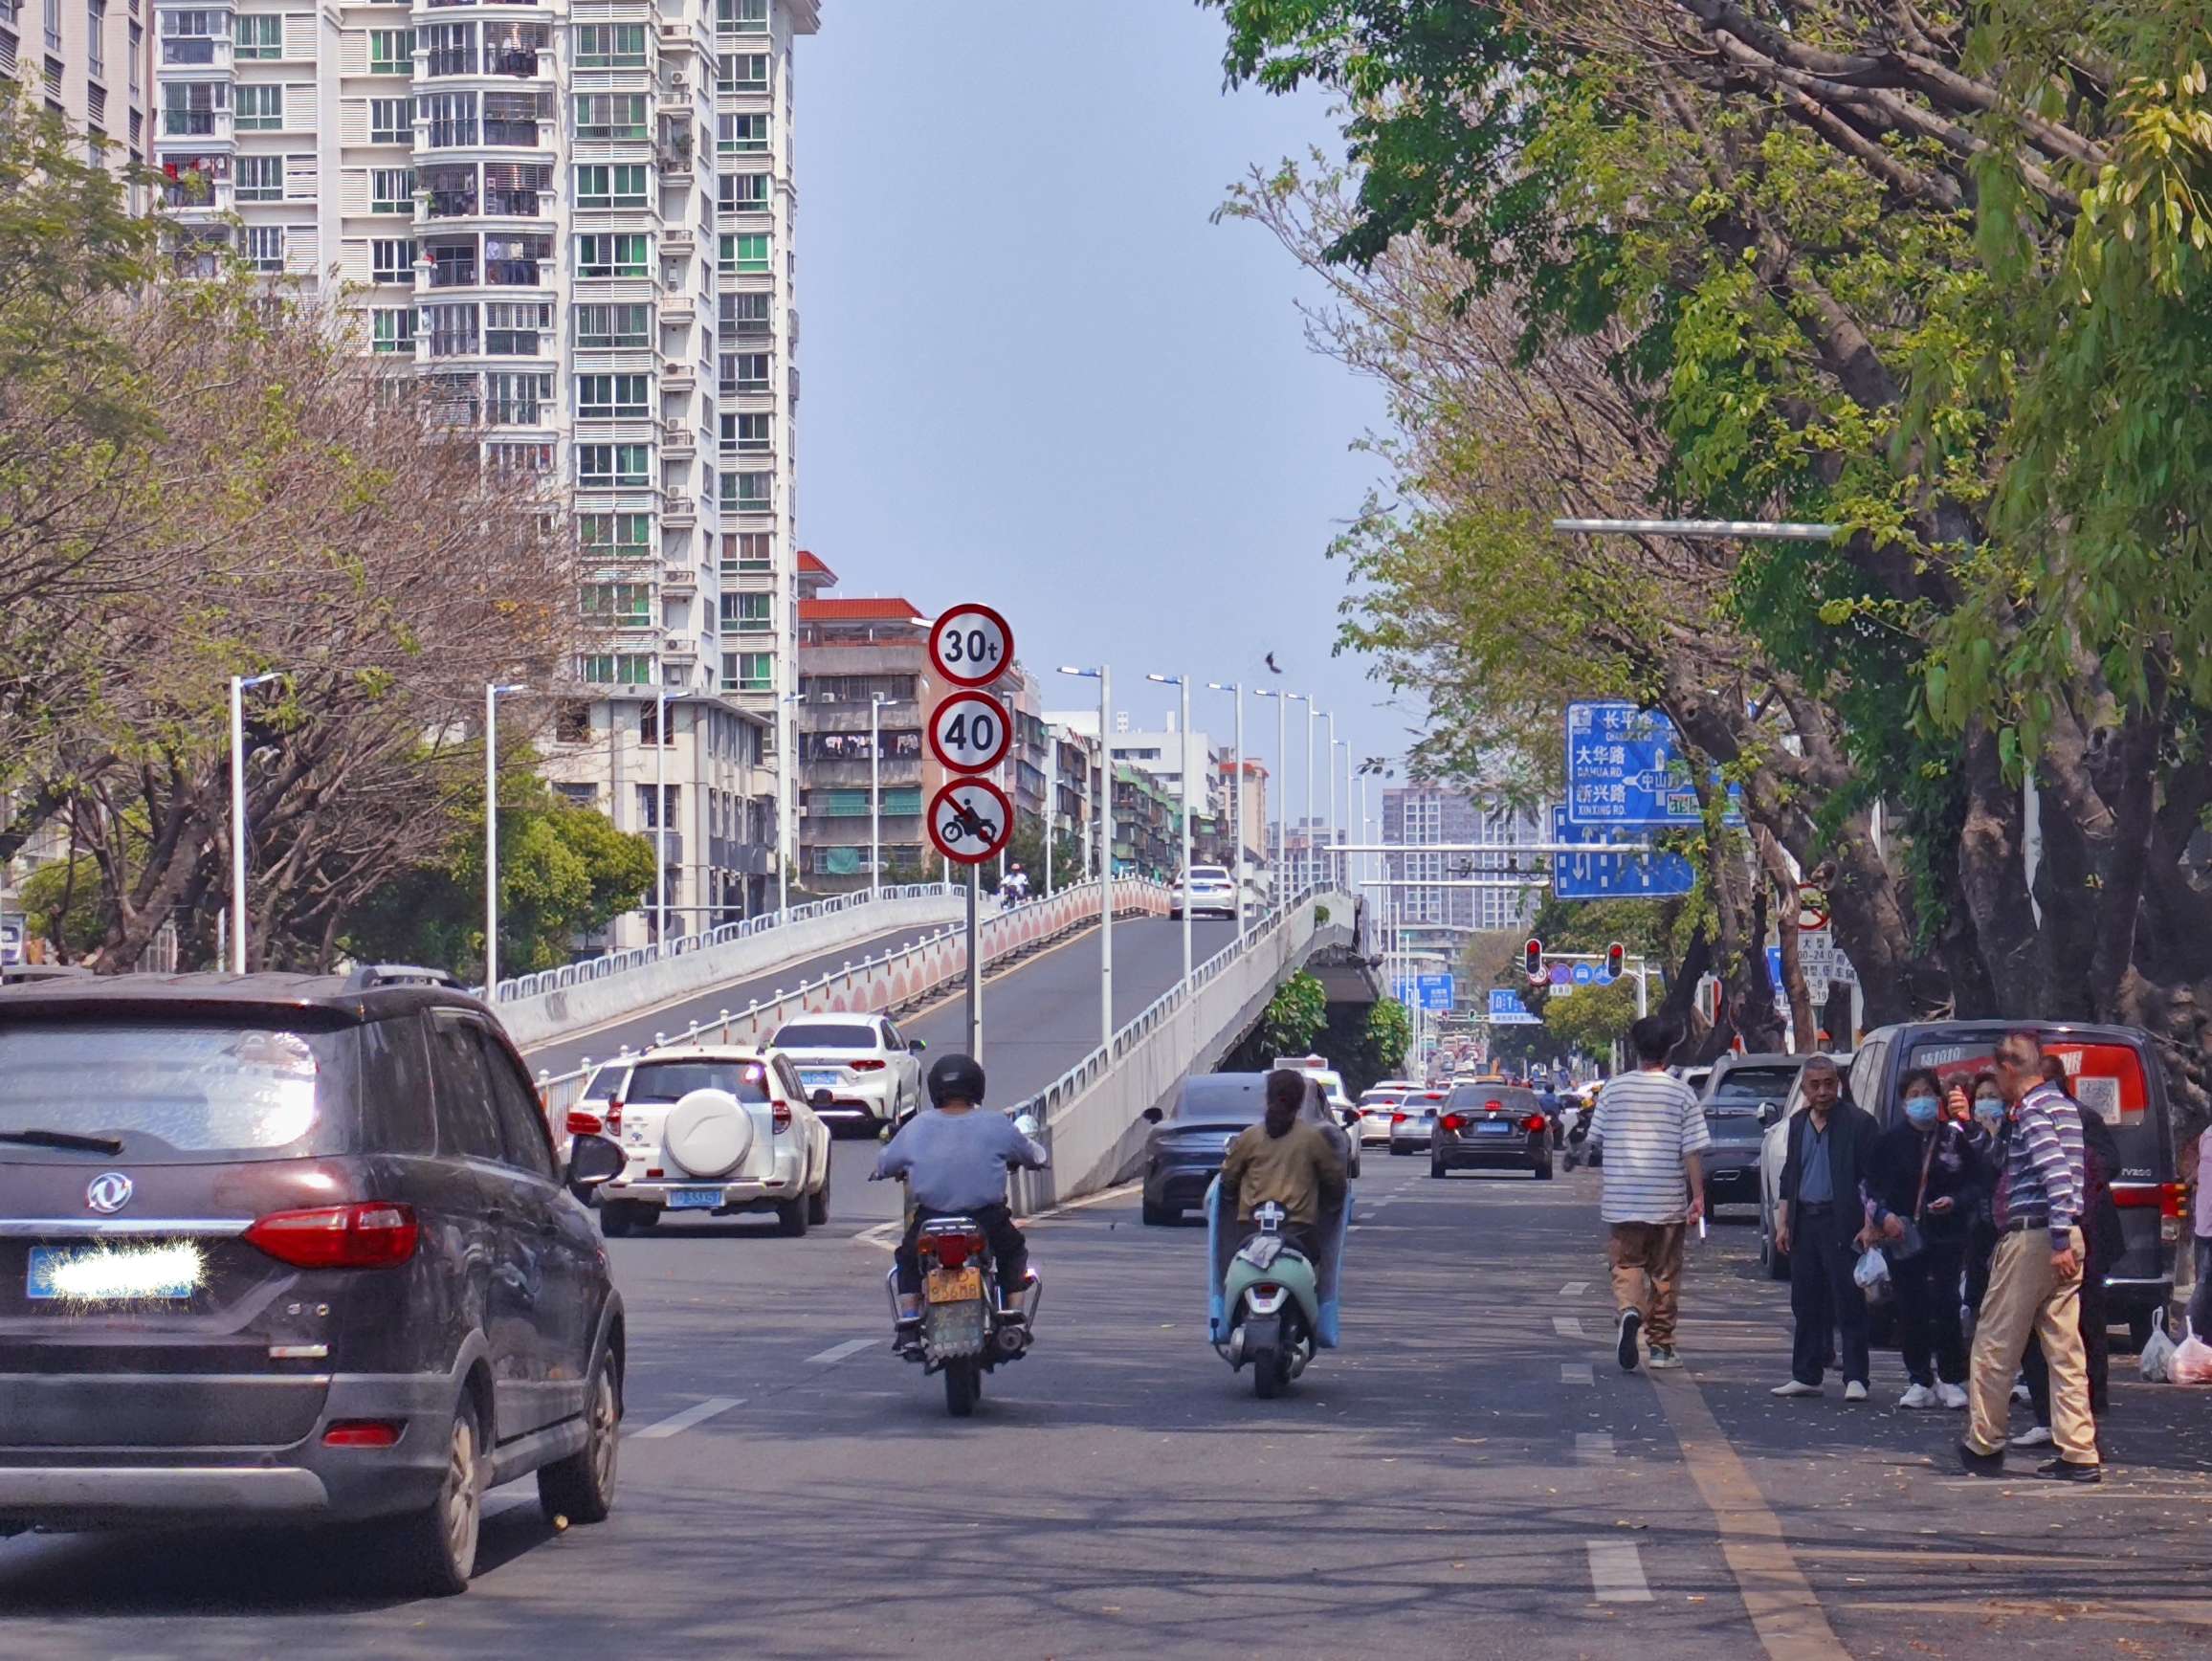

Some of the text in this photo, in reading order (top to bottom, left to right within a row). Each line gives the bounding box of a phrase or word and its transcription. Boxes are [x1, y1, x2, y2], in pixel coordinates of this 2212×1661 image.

[944, 630, 998, 662] 30t
[944, 714, 993, 751] 40
[1577, 745, 1626, 765] 大华路
[1577, 766, 1608, 777] DAHUA
[1577, 784, 1626, 804] 新兴路
